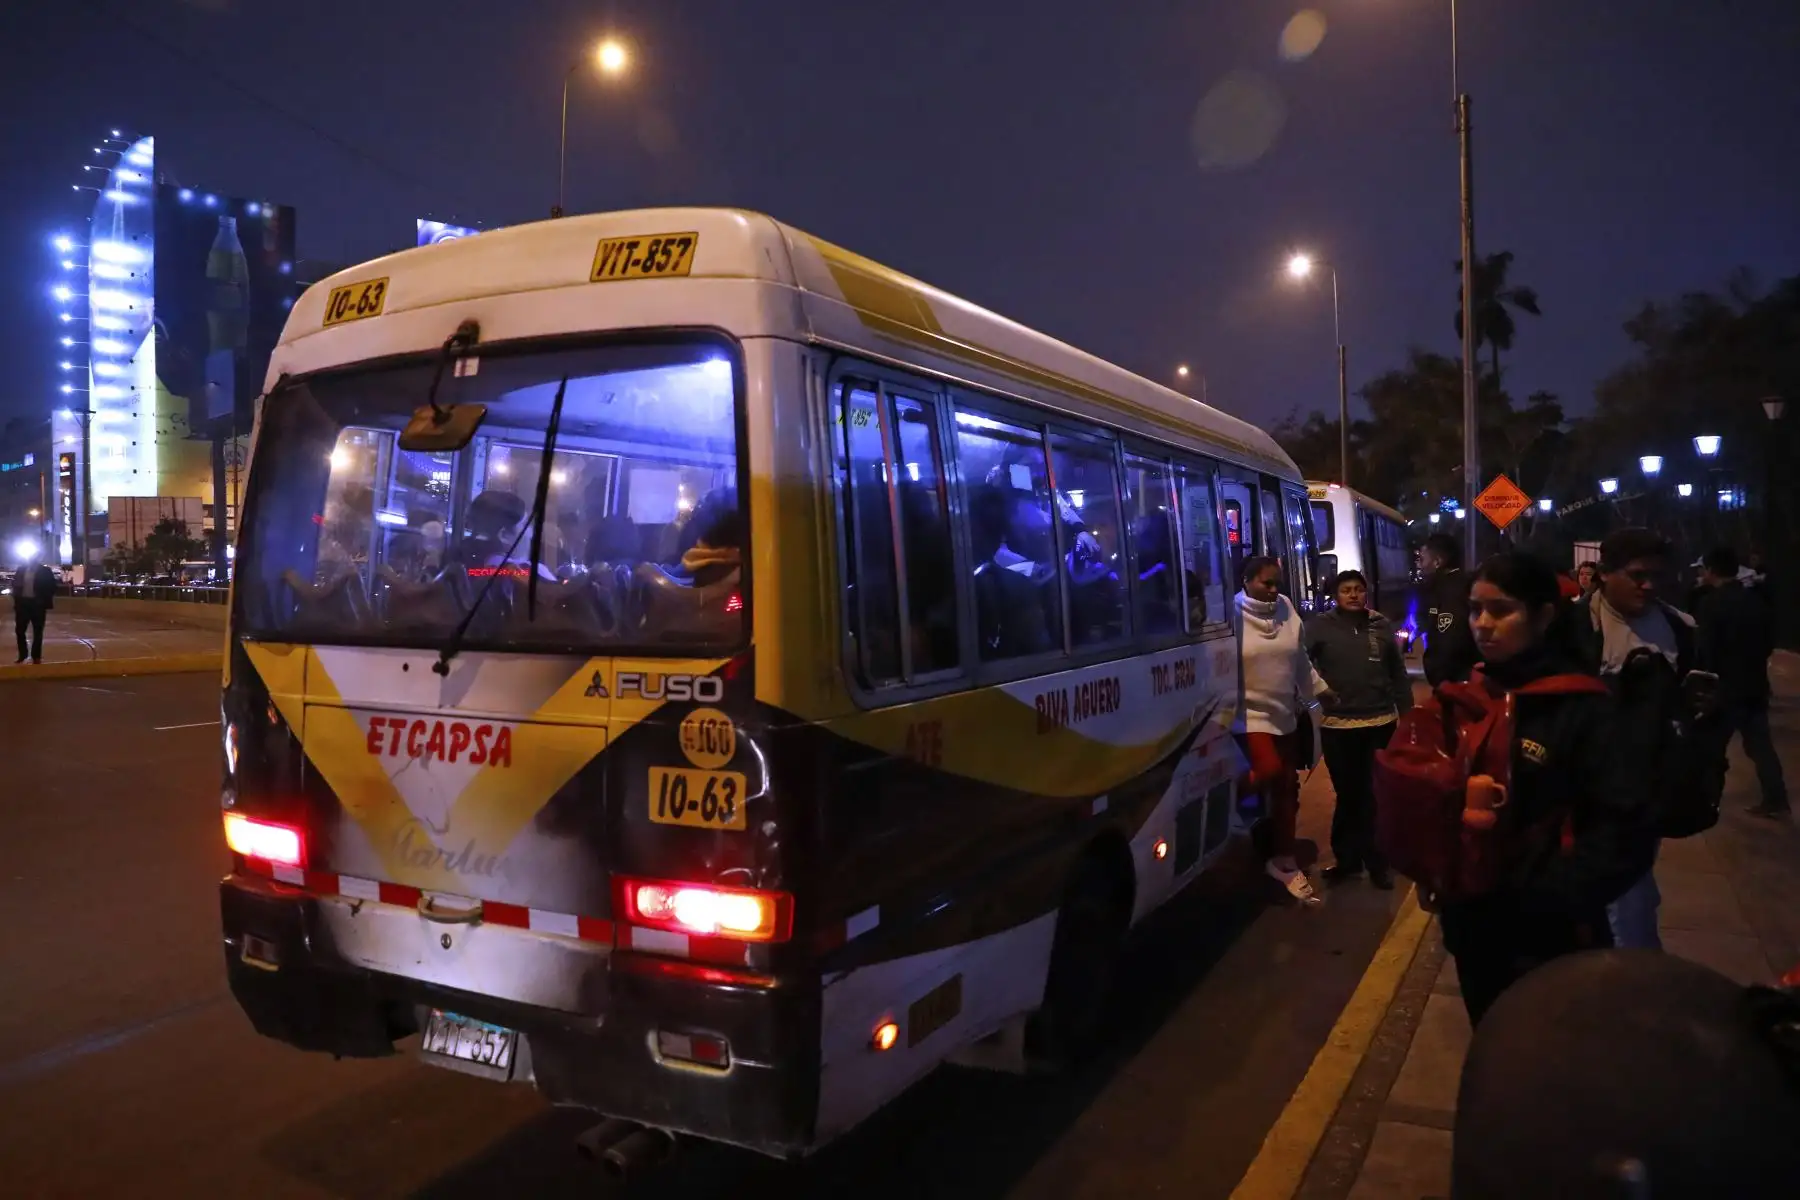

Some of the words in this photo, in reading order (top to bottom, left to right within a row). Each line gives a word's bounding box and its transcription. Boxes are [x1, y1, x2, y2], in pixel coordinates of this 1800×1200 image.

[326, 282, 385, 321] 10-63
[616, 672, 723, 703] FUSO
[1073, 676, 1121, 723] AGUERO
[367, 716, 512, 769] ETCAPSA
[657, 772, 738, 825] 10-63
